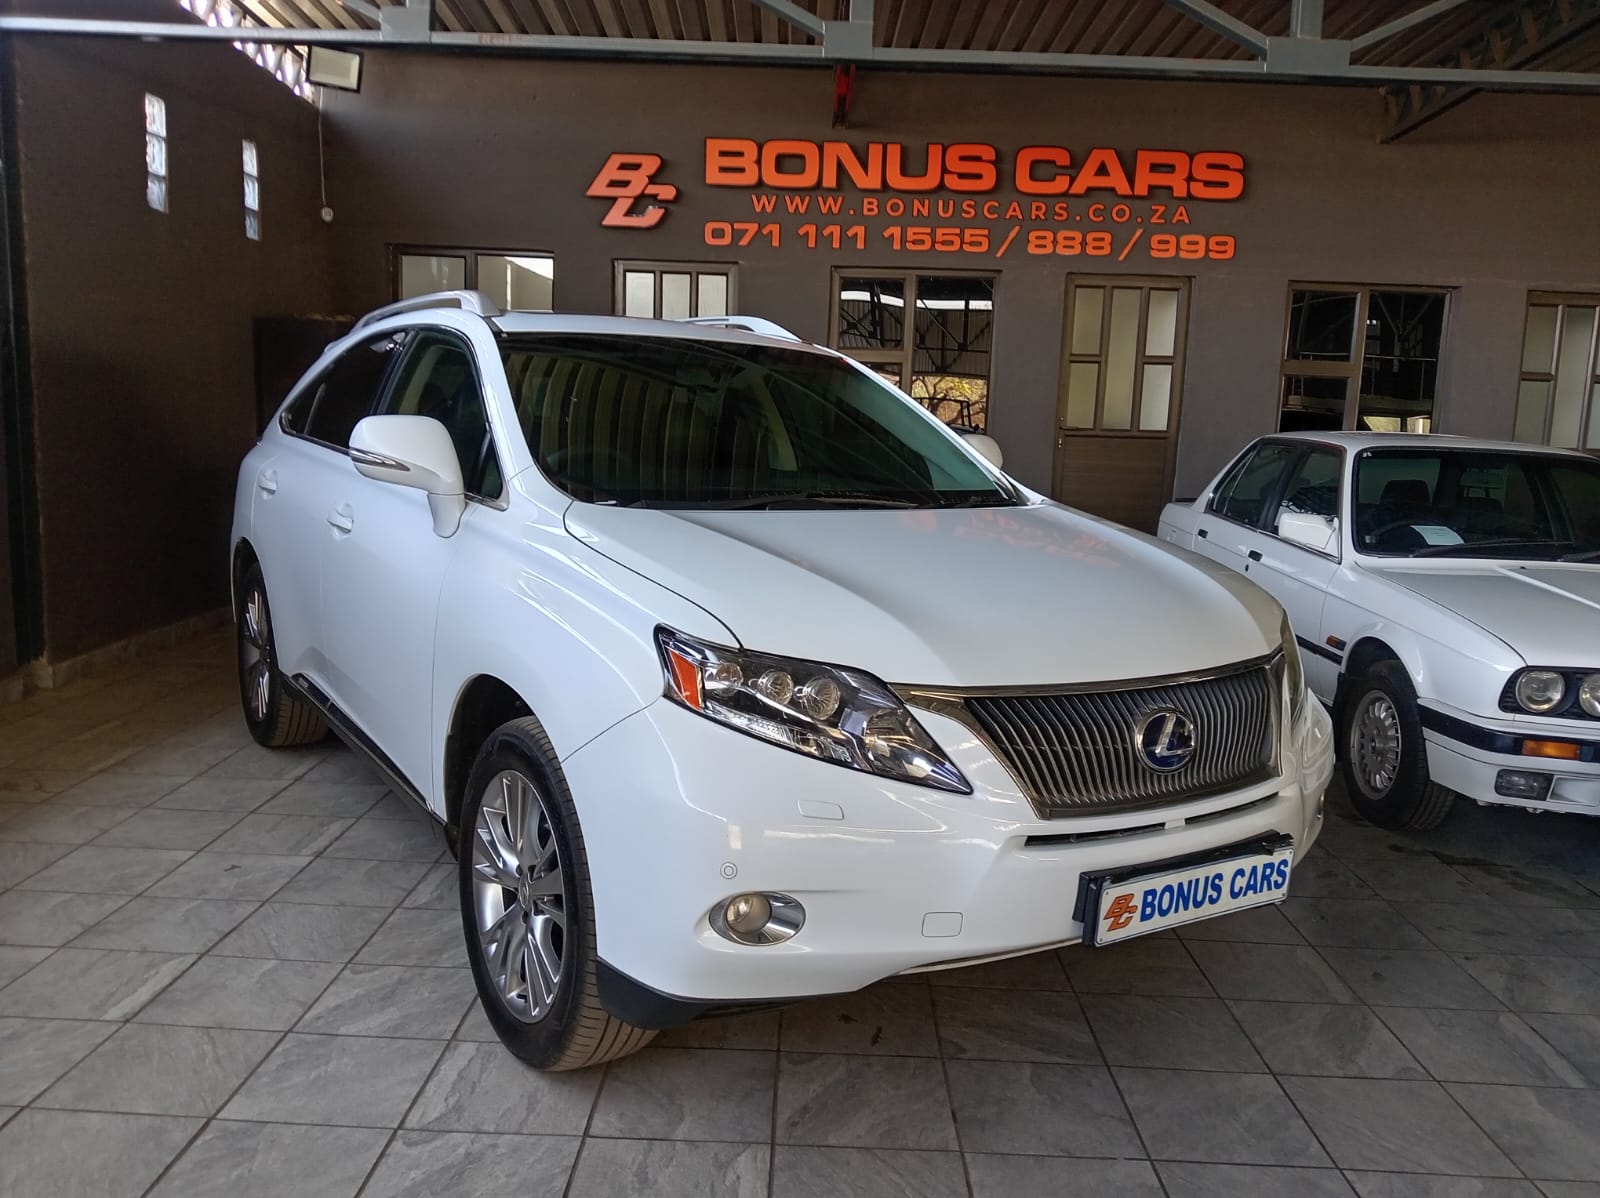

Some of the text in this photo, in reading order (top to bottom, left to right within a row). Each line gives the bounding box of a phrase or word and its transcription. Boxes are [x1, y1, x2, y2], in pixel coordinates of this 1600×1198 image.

[705, 138, 1245, 200] BONUS CARS
[751, 194, 1191, 225] WWW.BONUSCARS.CO.ZA
[704, 221, 781, 248] 071
[798, 223, 865, 249] 111
[1139, 873, 1223, 922] BONUS
[1229, 858, 1288, 899] CARS
